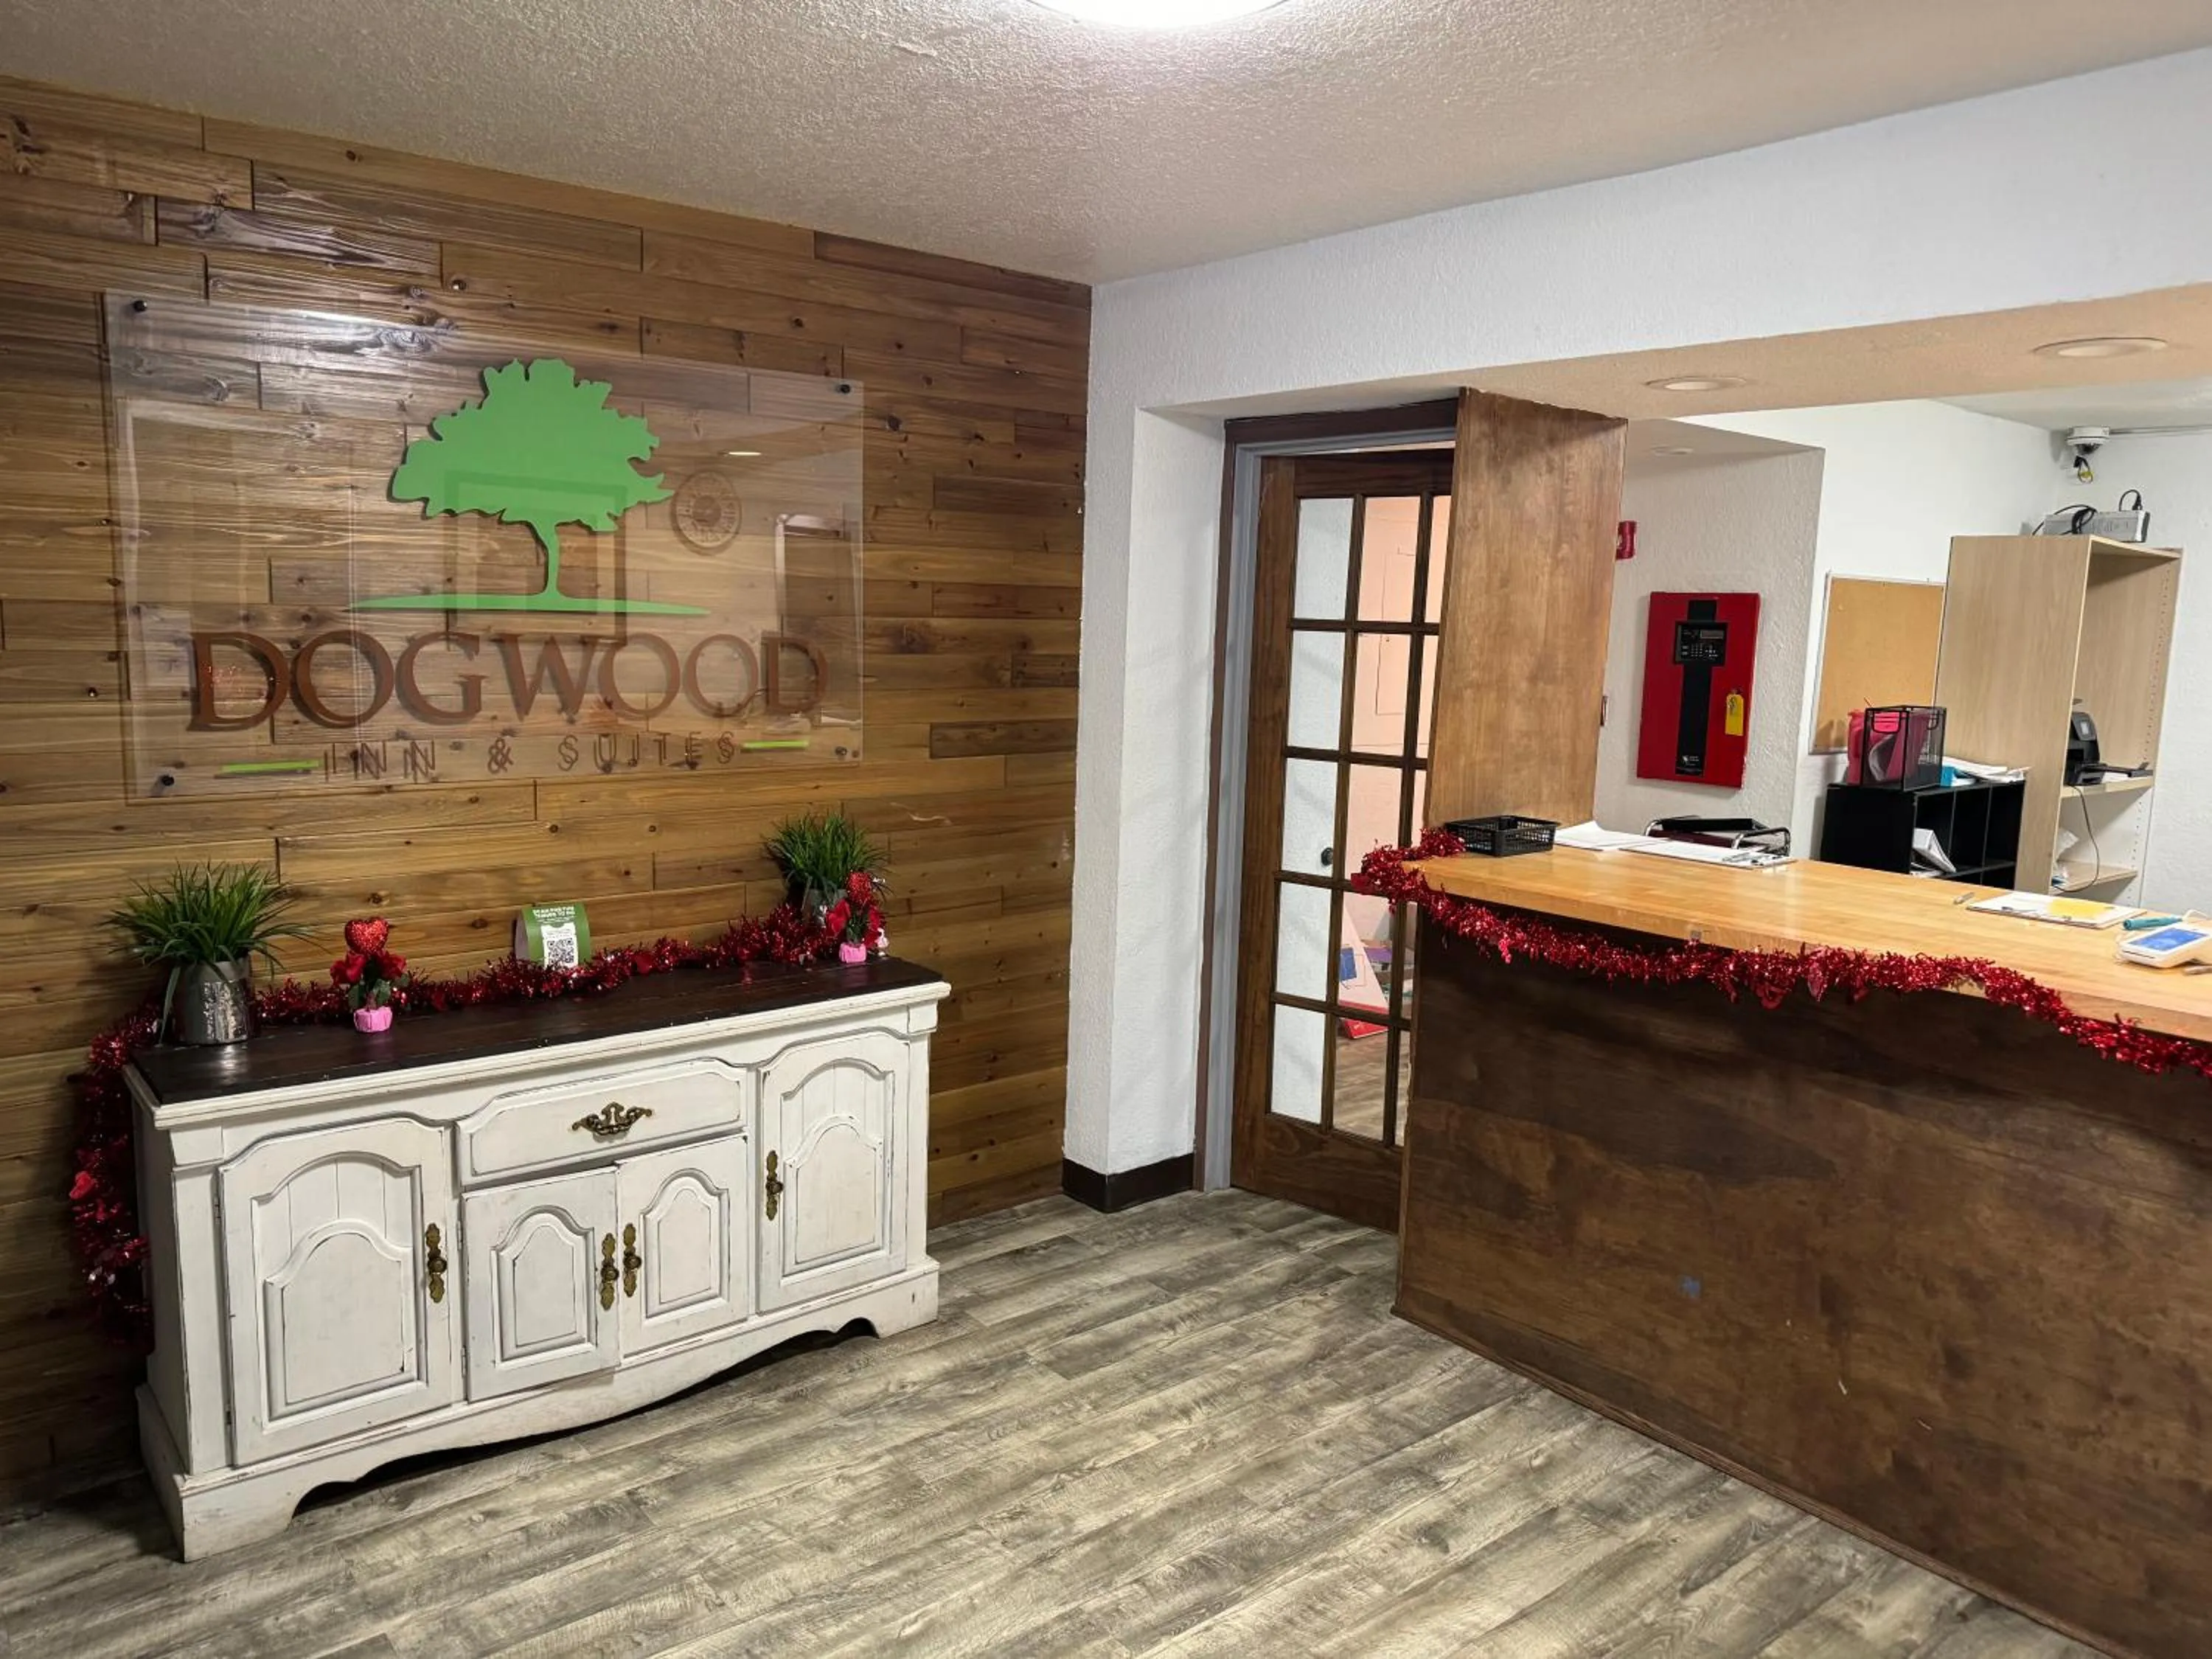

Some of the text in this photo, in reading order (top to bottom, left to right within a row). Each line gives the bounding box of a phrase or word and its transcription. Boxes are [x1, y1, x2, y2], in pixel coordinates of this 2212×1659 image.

[188, 630, 828, 730] DOGWOOD
[327, 731, 735, 779] INN & SUITES
